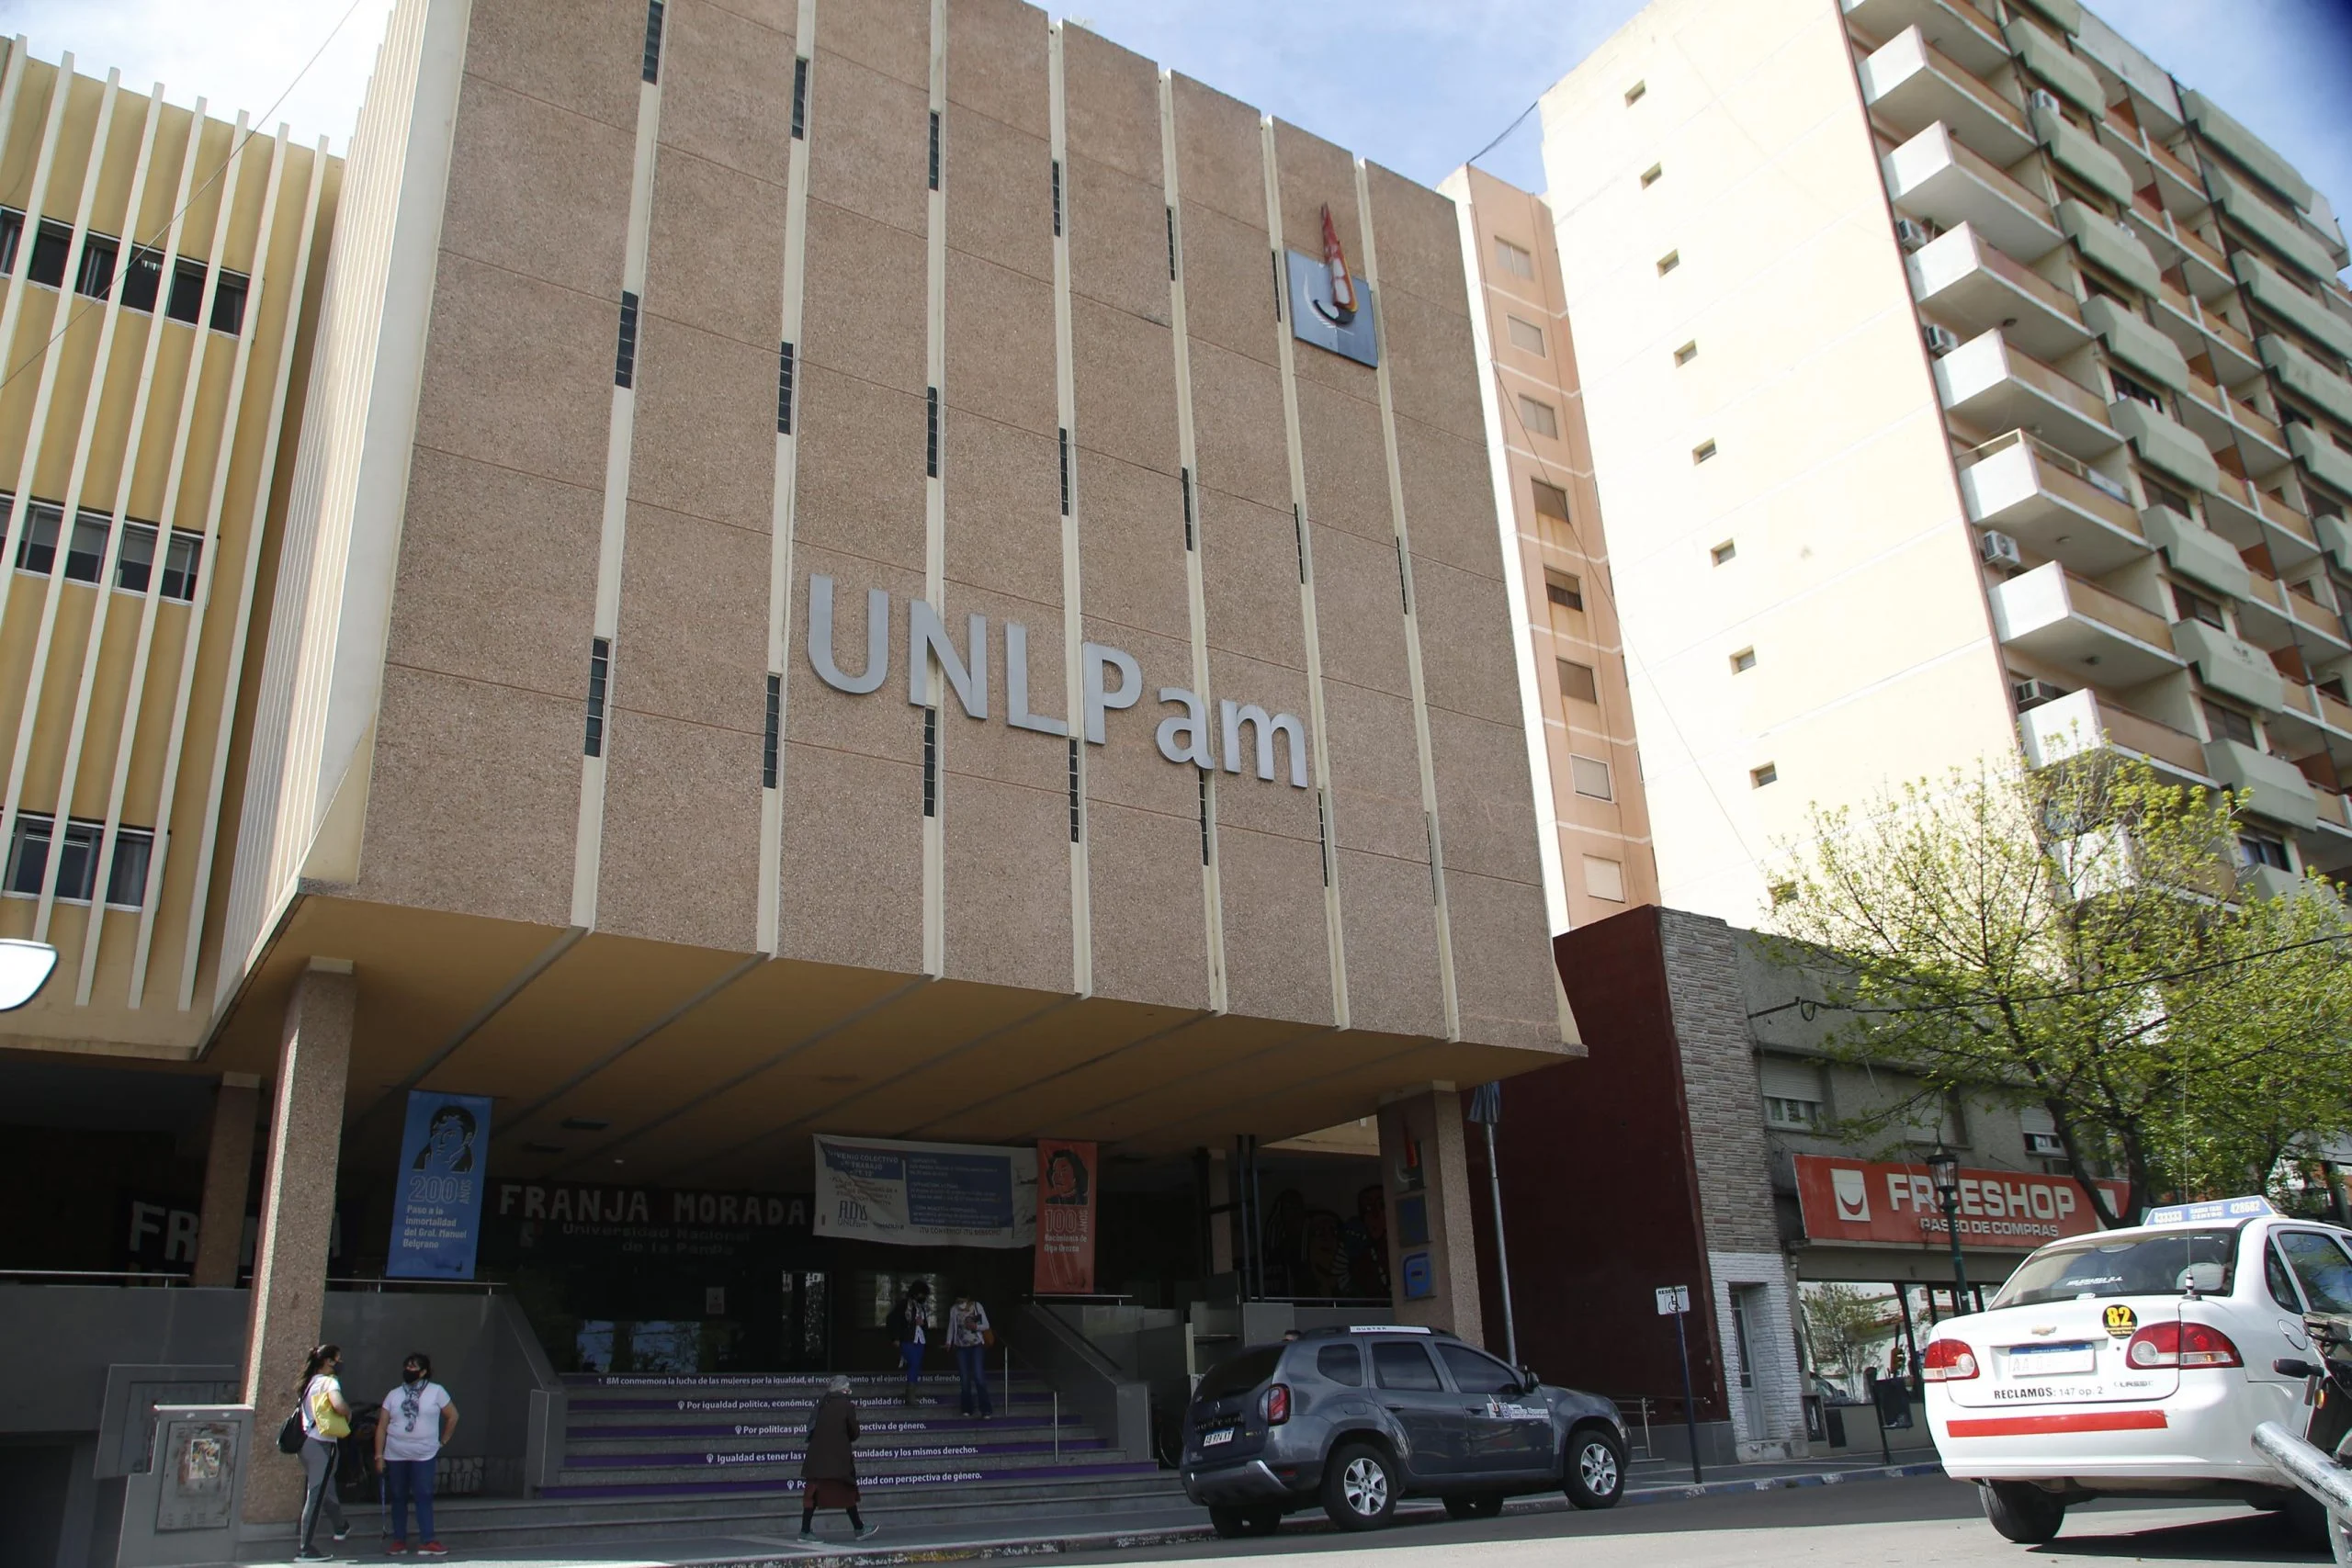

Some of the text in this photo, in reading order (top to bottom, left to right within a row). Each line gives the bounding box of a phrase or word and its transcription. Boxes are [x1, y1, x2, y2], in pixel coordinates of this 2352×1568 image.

[808, 573, 1308, 790] UNLPam
[408, 1175, 458, 1204] 200
[406, 1204, 427, 1215] Paso
[499, 1183, 808, 1228] FRANJA MORADA
[405, 1215, 458, 1227] inmortalidad
[1045, 1208, 1078, 1233] 100
[1971, 1220, 1991, 1234] DE
[1992, 1222, 2059, 1237] COMPRAS
[403, 1227, 417, 1237] del
[438, 1229, 467, 1240] Manuel
[561, 1223, 671, 1240] Universidad
[401, 1238, 439, 1250] Belgrano
[2106, 1306, 2132, 1327] 82
[606, 1377, 619, 1386] 8M
[620, 1378, 668, 1386] conmemora
[668, 1377, 676, 1385] la
[676, 1377, 697, 1385] lucha
[697, 1377, 708, 1385] de
[708, 1377, 720, 1385] las
[720, 1376, 751, 1386] mujeres
[751, 1378, 763, 1387] por
[764, 1376, 774, 1385] la
[807, 1375, 815, 1384] el
[933, 1374, 961, 1382] derecho
[1994, 1386, 2056, 1400] RECLAMOS:
[2059, 1387, 2075, 1397] 147
[2097, 1385, 2104, 1394] 2
[687, 1400, 703, 1410] Por
[702, 1399, 738, 1411] igualdad
[739, 1398, 771, 1410] política,
[771, 1397, 816, 1409] económica,
[859, 1396, 892, 1408] igualdad
[743, 1425, 758, 1435] Por
[758, 1424, 793, 1436] políticas
[888, 1420, 898, 1430] de
[898, 1420, 927, 1432] género.
[717, 1451, 755, 1464] Igualdad
[756, 1453, 766, 1461] es
[766, 1452, 789, 1461] tener
[790, 1450, 803, 1461] las
[893, 1450, 899, 1459] y
[900, 1447, 912, 1457] los
[912, 1447, 942, 1456] mismos
[942, 1445, 978, 1455] derechos.
[879, 1476, 894, 1484] con
[895, 1472, 942, 1485] perspectiva
[942, 1472, 953, 1481] de
[953, 1472, 983, 1483] género.
